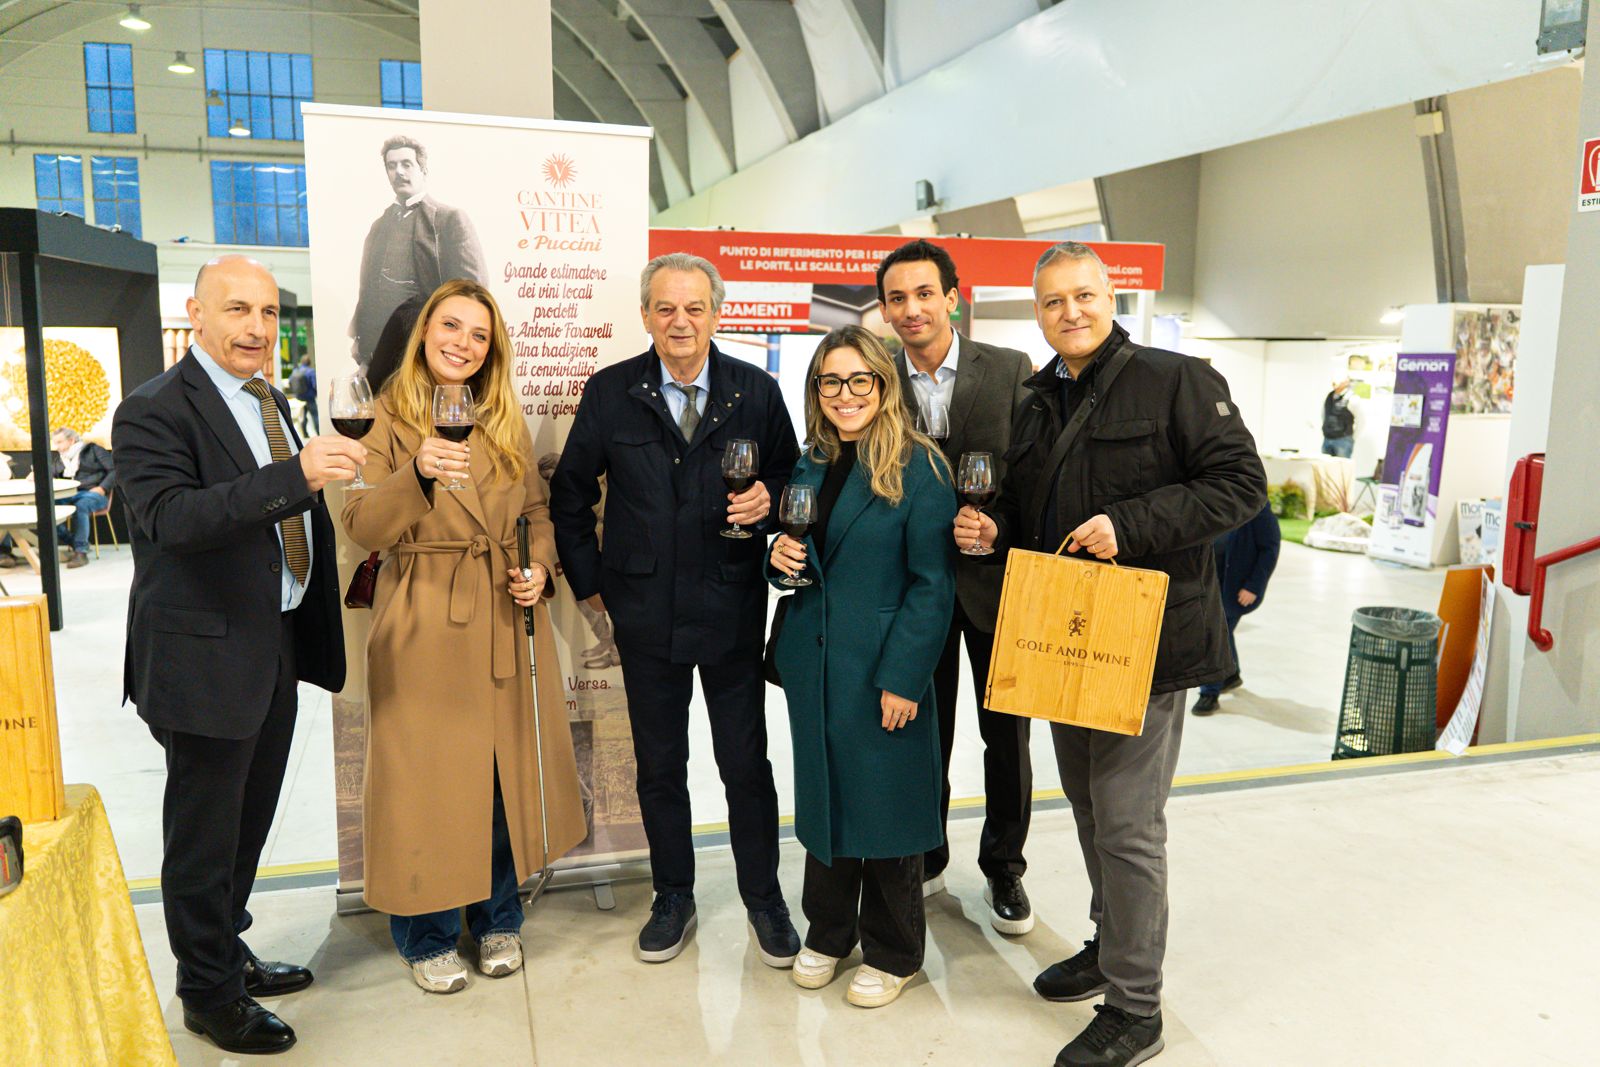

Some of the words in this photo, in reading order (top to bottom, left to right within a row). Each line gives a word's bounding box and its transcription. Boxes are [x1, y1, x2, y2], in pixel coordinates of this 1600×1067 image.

[517, 189, 602, 209] CANTINE
[1581, 197, 1600, 207] ESTI
[520, 210, 601, 234] VITEA
[517, 238, 529, 249] e
[533, 235, 602, 252] Puccini
[719, 245, 758, 257] PUNTO
[759, 246, 771, 257] DI
[773, 247, 844, 259] RIFERIMENTO
[845, 249, 865, 259] PER
[504, 261, 548, 283] Grande
[550, 263, 607, 280] estimatore
[740, 260, 753, 270] LE
[755, 260, 793, 272] PORTE,
[794, 261, 808, 271] LE
[809, 262, 845, 273] SCALE,
[846, 262, 860, 272] LA
[861, 263, 880, 273] SIC
[517, 282, 535, 299] dei
[538, 283, 559, 299] vini
[562, 282, 593, 300] locali
[532, 303, 578, 322] prodotti
[721, 303, 792, 317] RAMENTI
[516, 321, 563, 338] Antonio
[564, 322, 613, 339] Faravelli
[514, 341, 539, 357] Una
[541, 342, 598, 361] tradizione
[516, 361, 528, 377] di
[521, 381, 541, 396] che
[543, 381, 563, 396] dal
[566, 380, 586, 396] 189
[537, 400, 549, 415] ai
[1016, 638, 1054, 653] GOLF
[1056, 645, 1088, 660] AND
[1093, 651, 1132, 667] WINE
[567, 676, 611, 691] Versa.
[0, 715, 38, 731] INE
